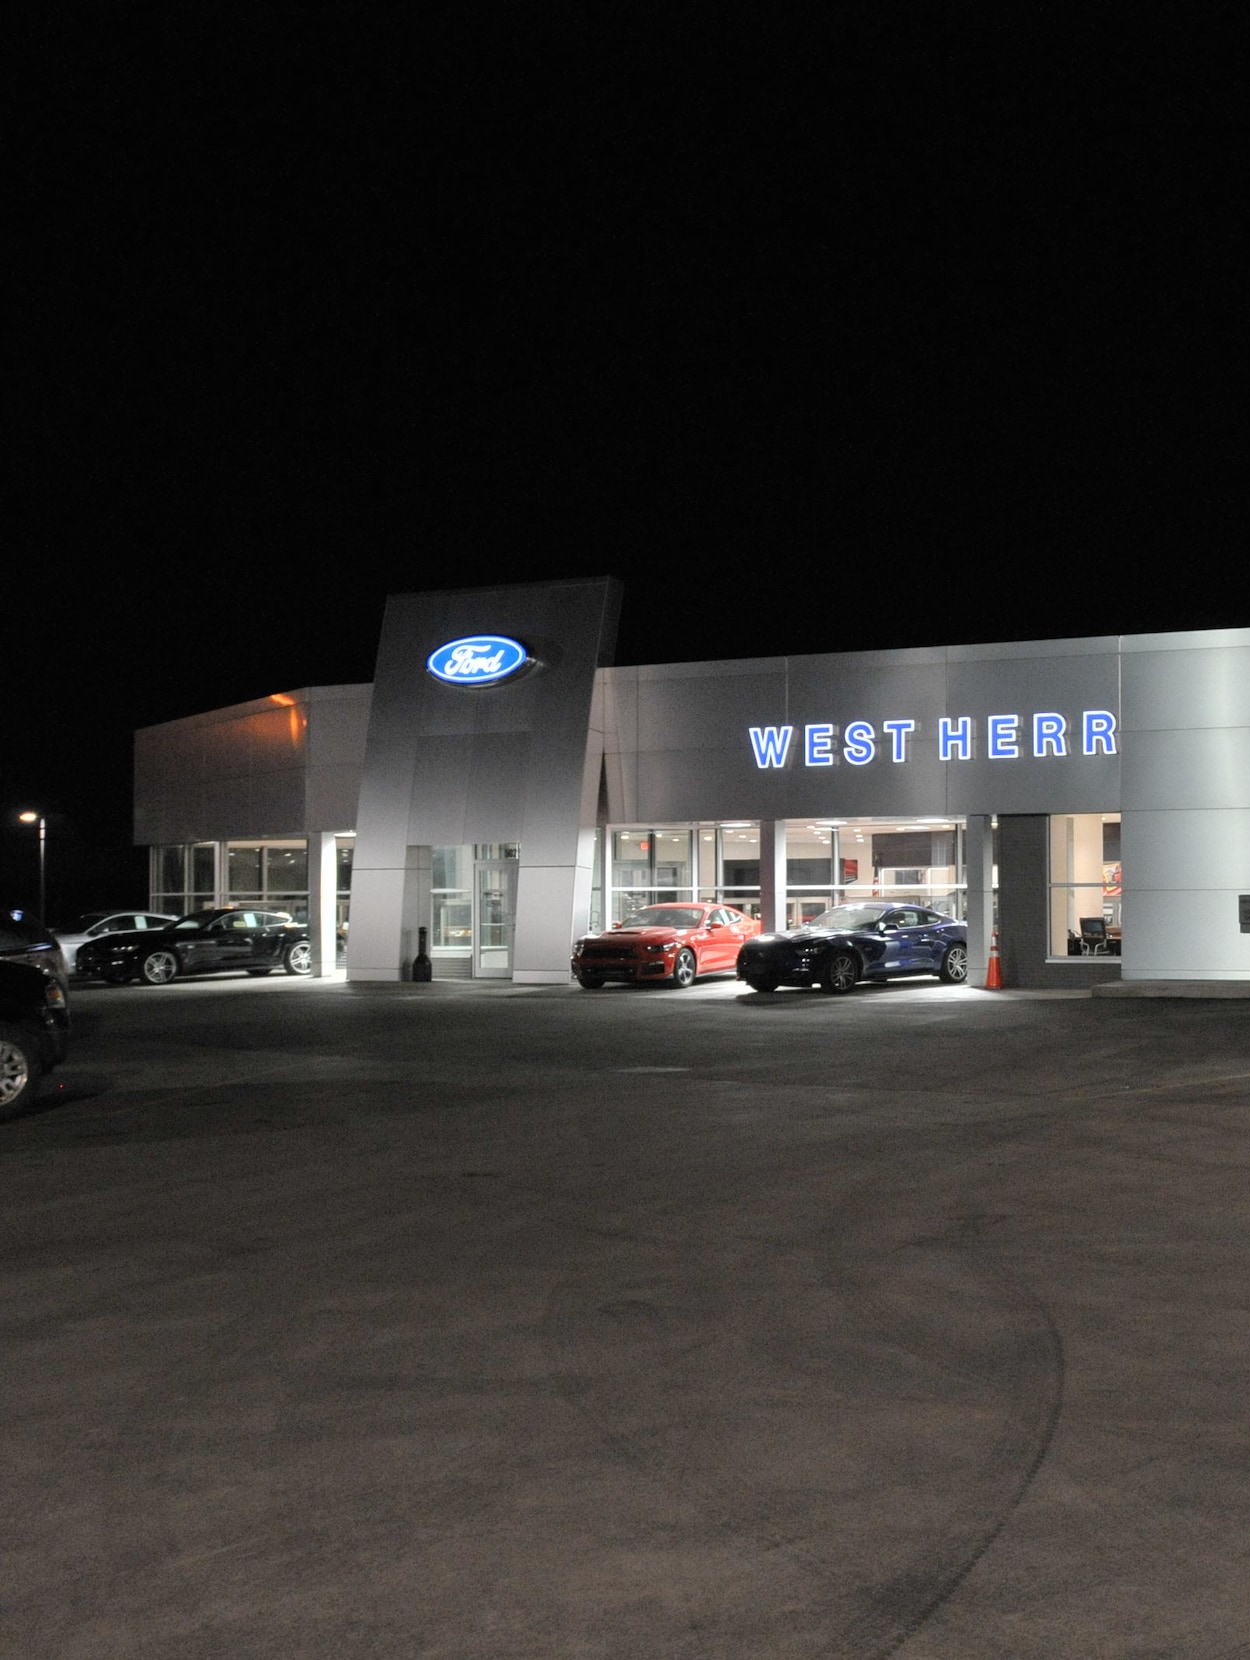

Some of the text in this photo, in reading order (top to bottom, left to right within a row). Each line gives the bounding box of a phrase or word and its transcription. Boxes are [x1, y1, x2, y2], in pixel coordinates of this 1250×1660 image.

[444, 644, 505, 676] Ford
[749, 710, 1118, 769] WEST HERR
